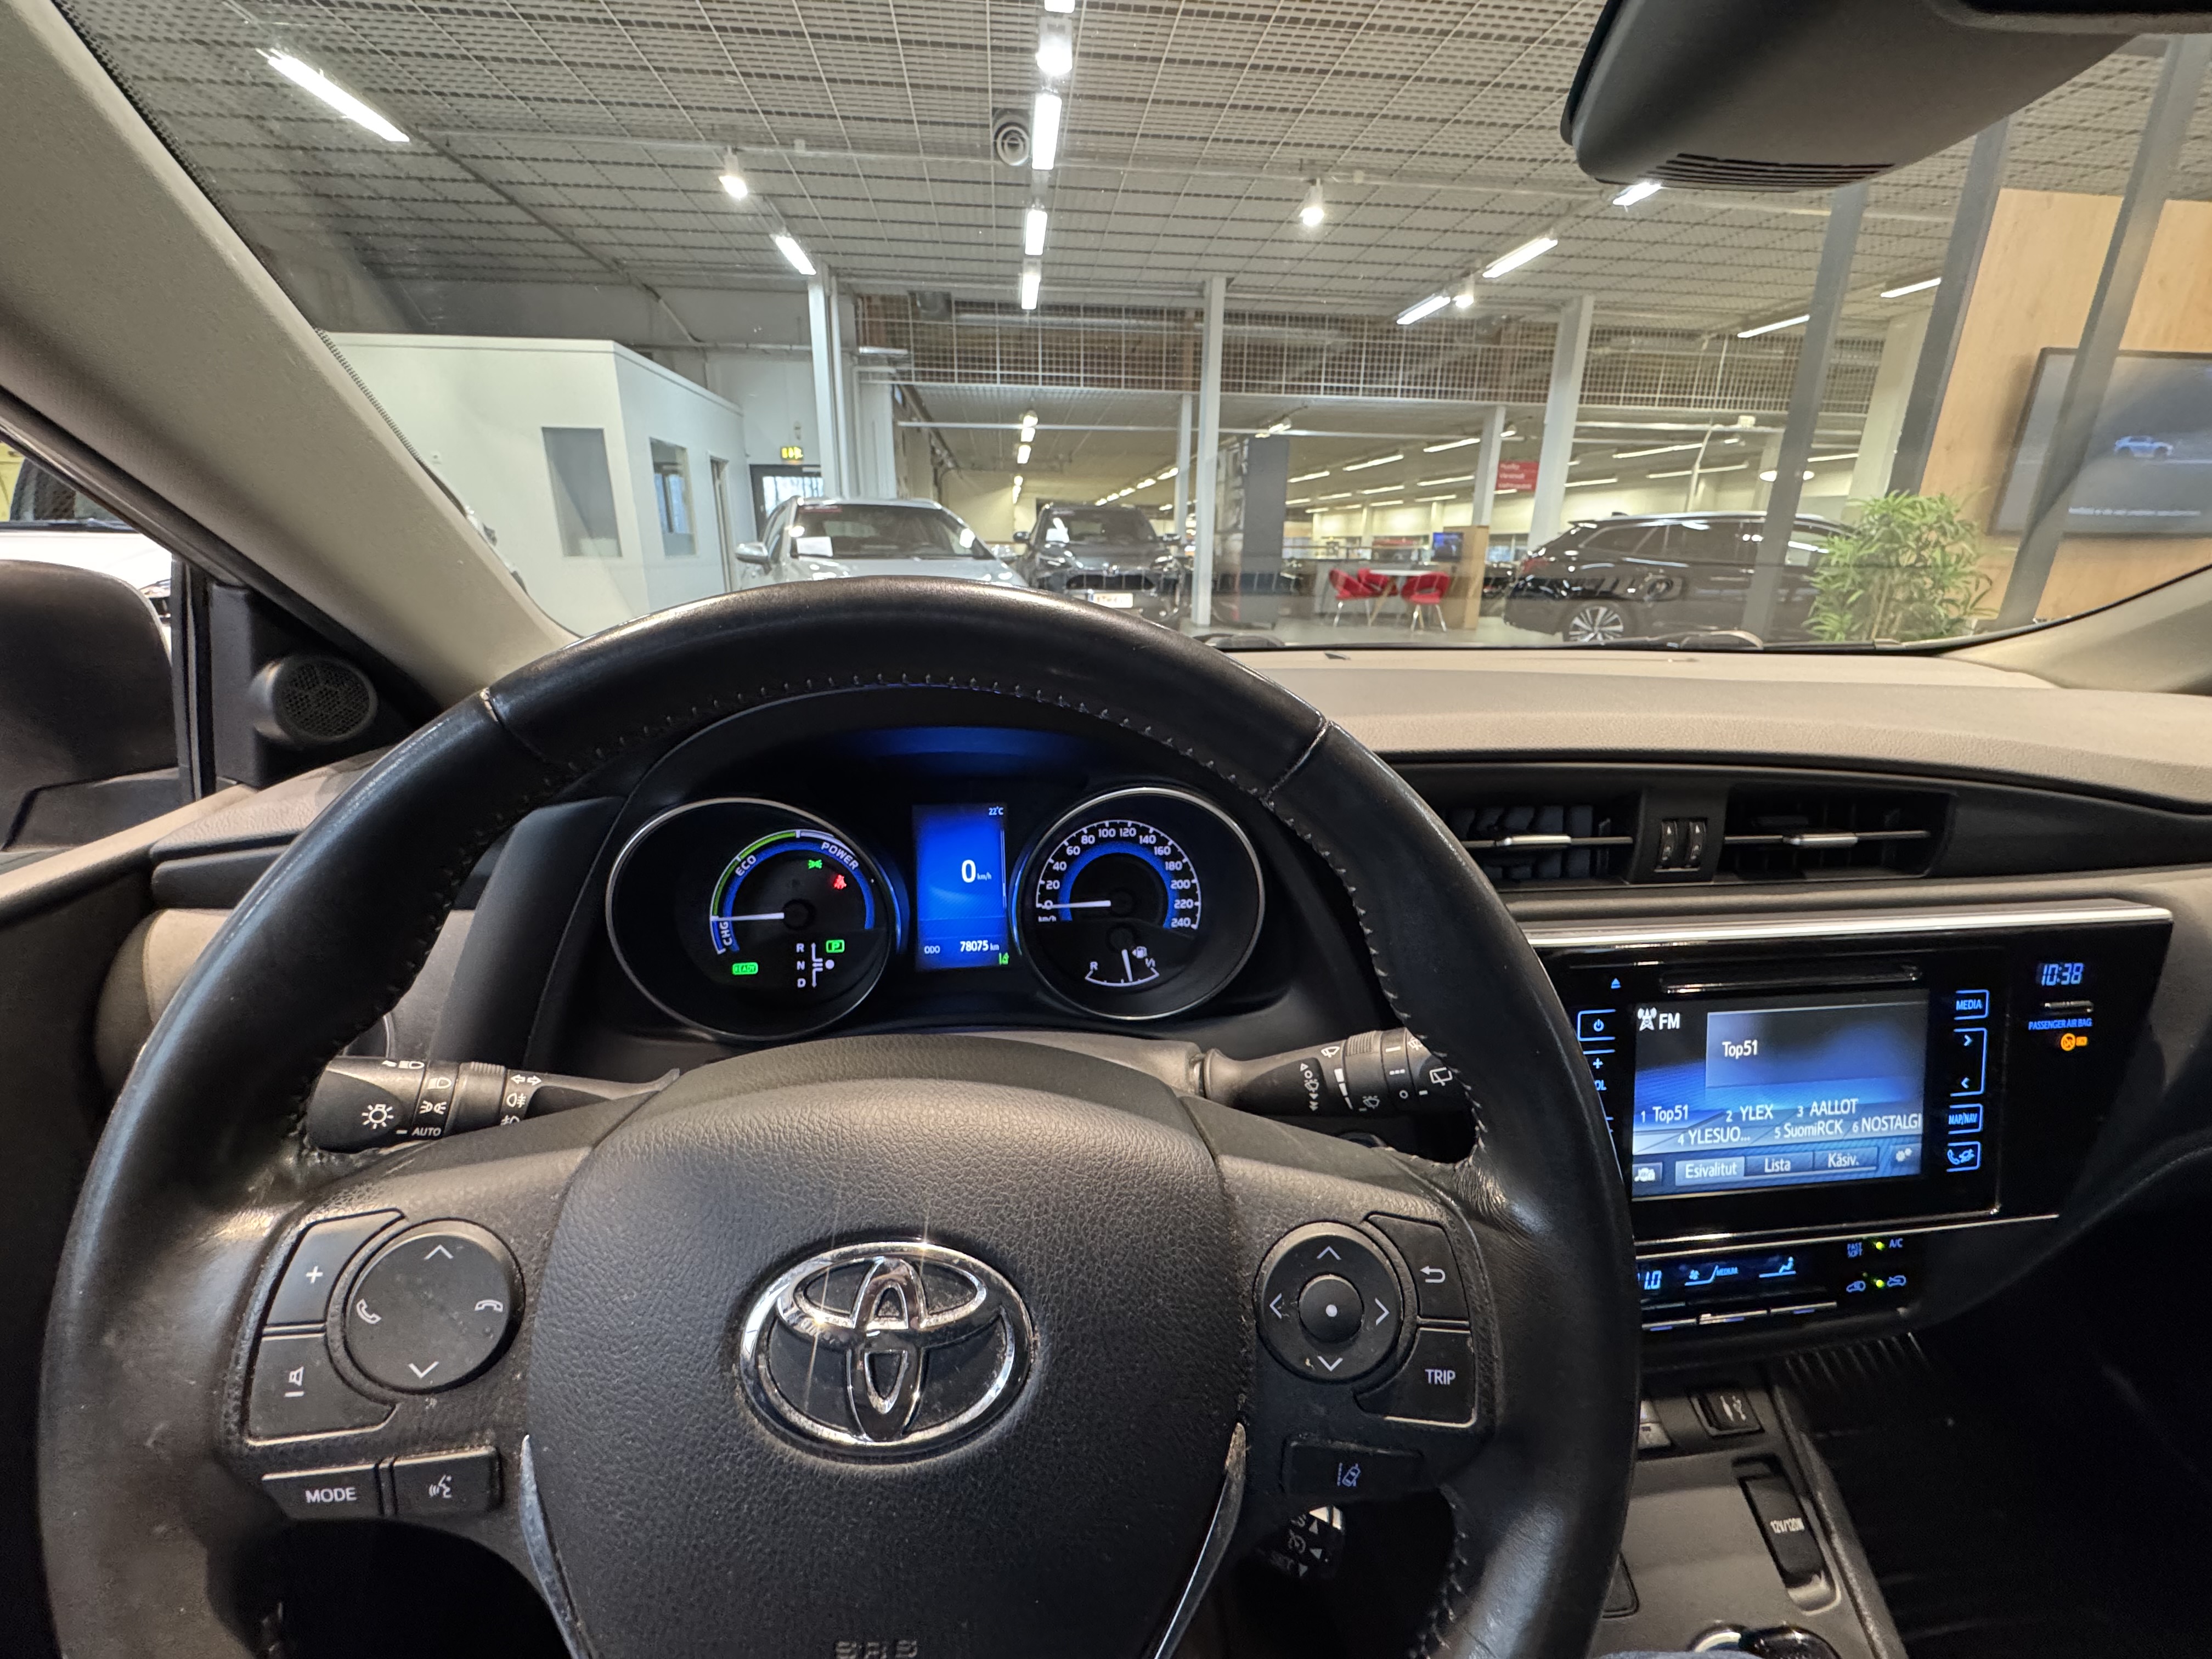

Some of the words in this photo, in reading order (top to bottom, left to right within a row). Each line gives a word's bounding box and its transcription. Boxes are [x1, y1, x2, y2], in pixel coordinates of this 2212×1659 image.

[1098, 828, 1116, 838] 100
[1119, 828, 1137, 837] 120
[1081, 834, 1096, 845] 80
[1139, 834, 1156, 844] 140
[821, 841, 859, 870] POWER
[1066, 845, 1081, 856] 60
[1154, 845, 1171, 855] 160
[735, 855, 757, 876] ECO
[962, 859, 976, 883] 0
[977, 871, 992, 881] km/h
[1053, 861, 1067, 871] 40
[1165, 861, 1183, 871] 180
[1046, 879, 1060, 890] 20
[1170, 879, 1191, 889] 200
[1044, 900, 1054, 910] 0
[1173, 898, 1194, 909] 220
[1171, 917, 1191, 928] 240
[719, 921, 733, 946] CHG
[796, 943, 805, 953] R
[832, 941, 840, 951] P
[924, 945, 940, 954] ODO
[960, 940, 989, 952] 78075
[797, 961, 805, 970] N
[1090, 961, 1098, 970] R
[2041, 962, 2084, 986] 10:38
[797, 978, 806, 988] D
[1956, 998, 1983, 1011] MEDIA
[1659, 1012, 1680, 1030] FM
[2028, 1019, 2066, 1030] PASSENGER
[2067, 1019, 2077, 1028] AIR
[2078, 1018, 2093, 1028] BAG
[1722, 1039, 1758, 1059] Top51
[1641, 1110, 1645, 1123] 1
[1652, 1104, 1689, 1124] Top51
[1726, 1110, 1733, 1122] 2
[1740, 1104, 1774, 1121] YLEX
[1797, 1105, 1804, 1118] 3
[1810, 1098, 1859, 1116] AALLOT
[1948, 1112, 1978, 1125] MAP/NAV
[411, 1127, 442, 1137] AUTO
[1774, 1126, 1781, 1139] 5
[1784, 1119, 1843, 1138] SuomiRCK
[1853, 1121, 1859, 1133] 6
[1678, 1133, 1684, 1146] 4
[1688, 1126, 1751, 1146] YLESUO...
[1764, 1158, 1791, 1173] Lista
[1827, 1153, 1859, 1168] Käsiv.
[1685, 1162, 1737, 1179] Esivalitut
[1889, 1238, 1903, 1248] A/C
[1425, 1368, 1456, 1385] TRIP
[305, 1487, 357, 1503] MODE
[1770, 1517, 1804, 1534] 12V/120W
